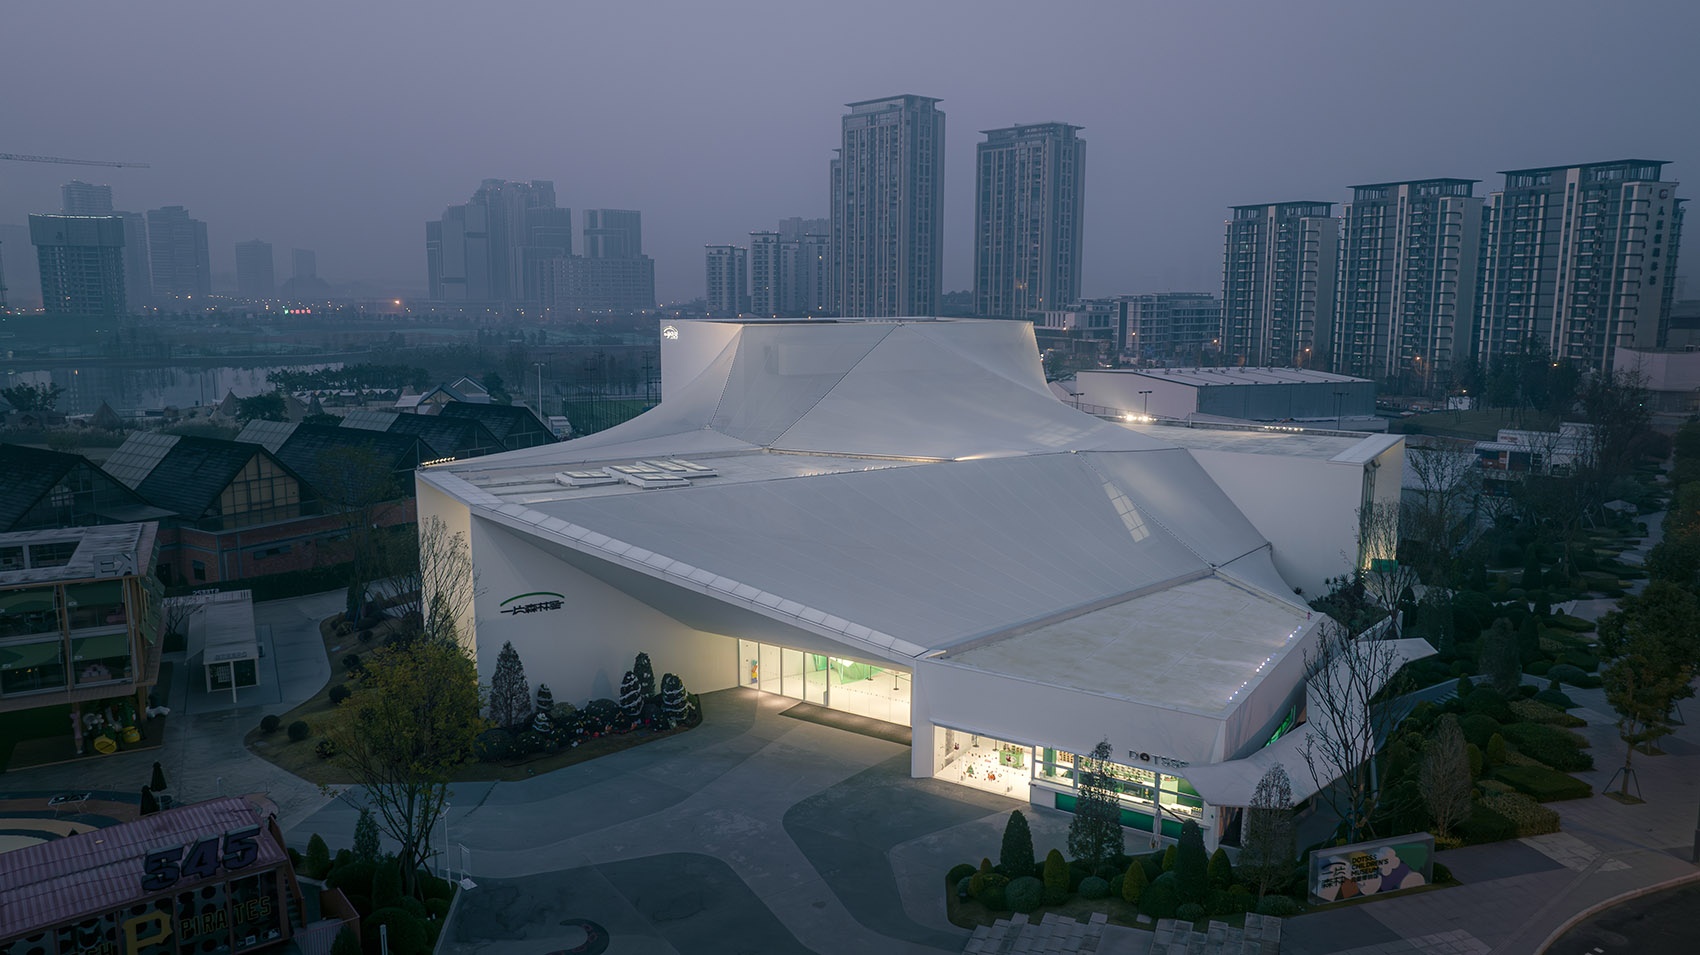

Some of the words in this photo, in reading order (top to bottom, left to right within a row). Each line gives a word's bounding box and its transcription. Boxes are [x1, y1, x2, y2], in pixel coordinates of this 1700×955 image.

[141, 824, 262, 891] 545
[1351, 859, 1389, 870] CHILDREN'S
[1351, 866, 1379, 876] MUSEUM
[122, 909, 175, 955] P
[180, 895, 273, 939] PIRATES
